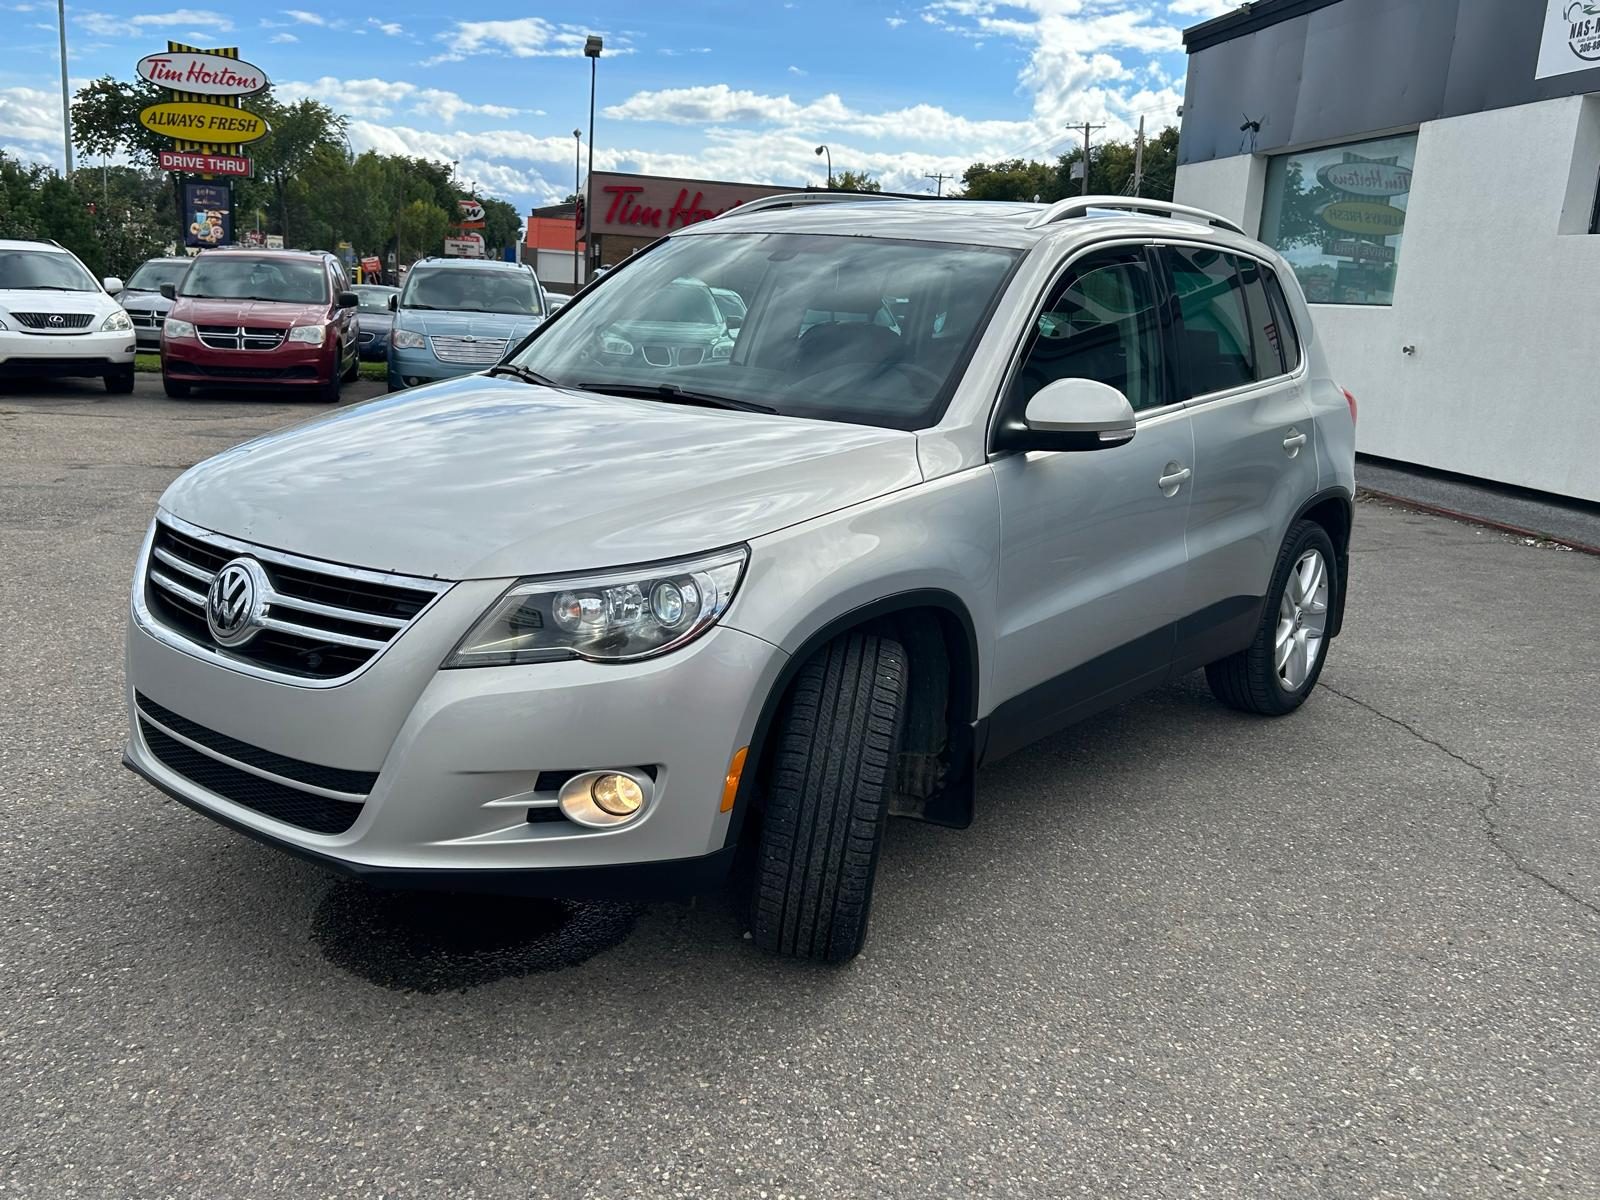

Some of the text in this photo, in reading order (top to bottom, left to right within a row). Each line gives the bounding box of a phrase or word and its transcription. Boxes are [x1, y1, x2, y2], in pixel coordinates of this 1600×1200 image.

[148, 59, 257, 89] Tim Hortons
[148, 112, 258, 132] ALWAYS FRESH
[164, 155, 245, 171] DRIVE THRU
[603, 186, 662, 228] Tim
